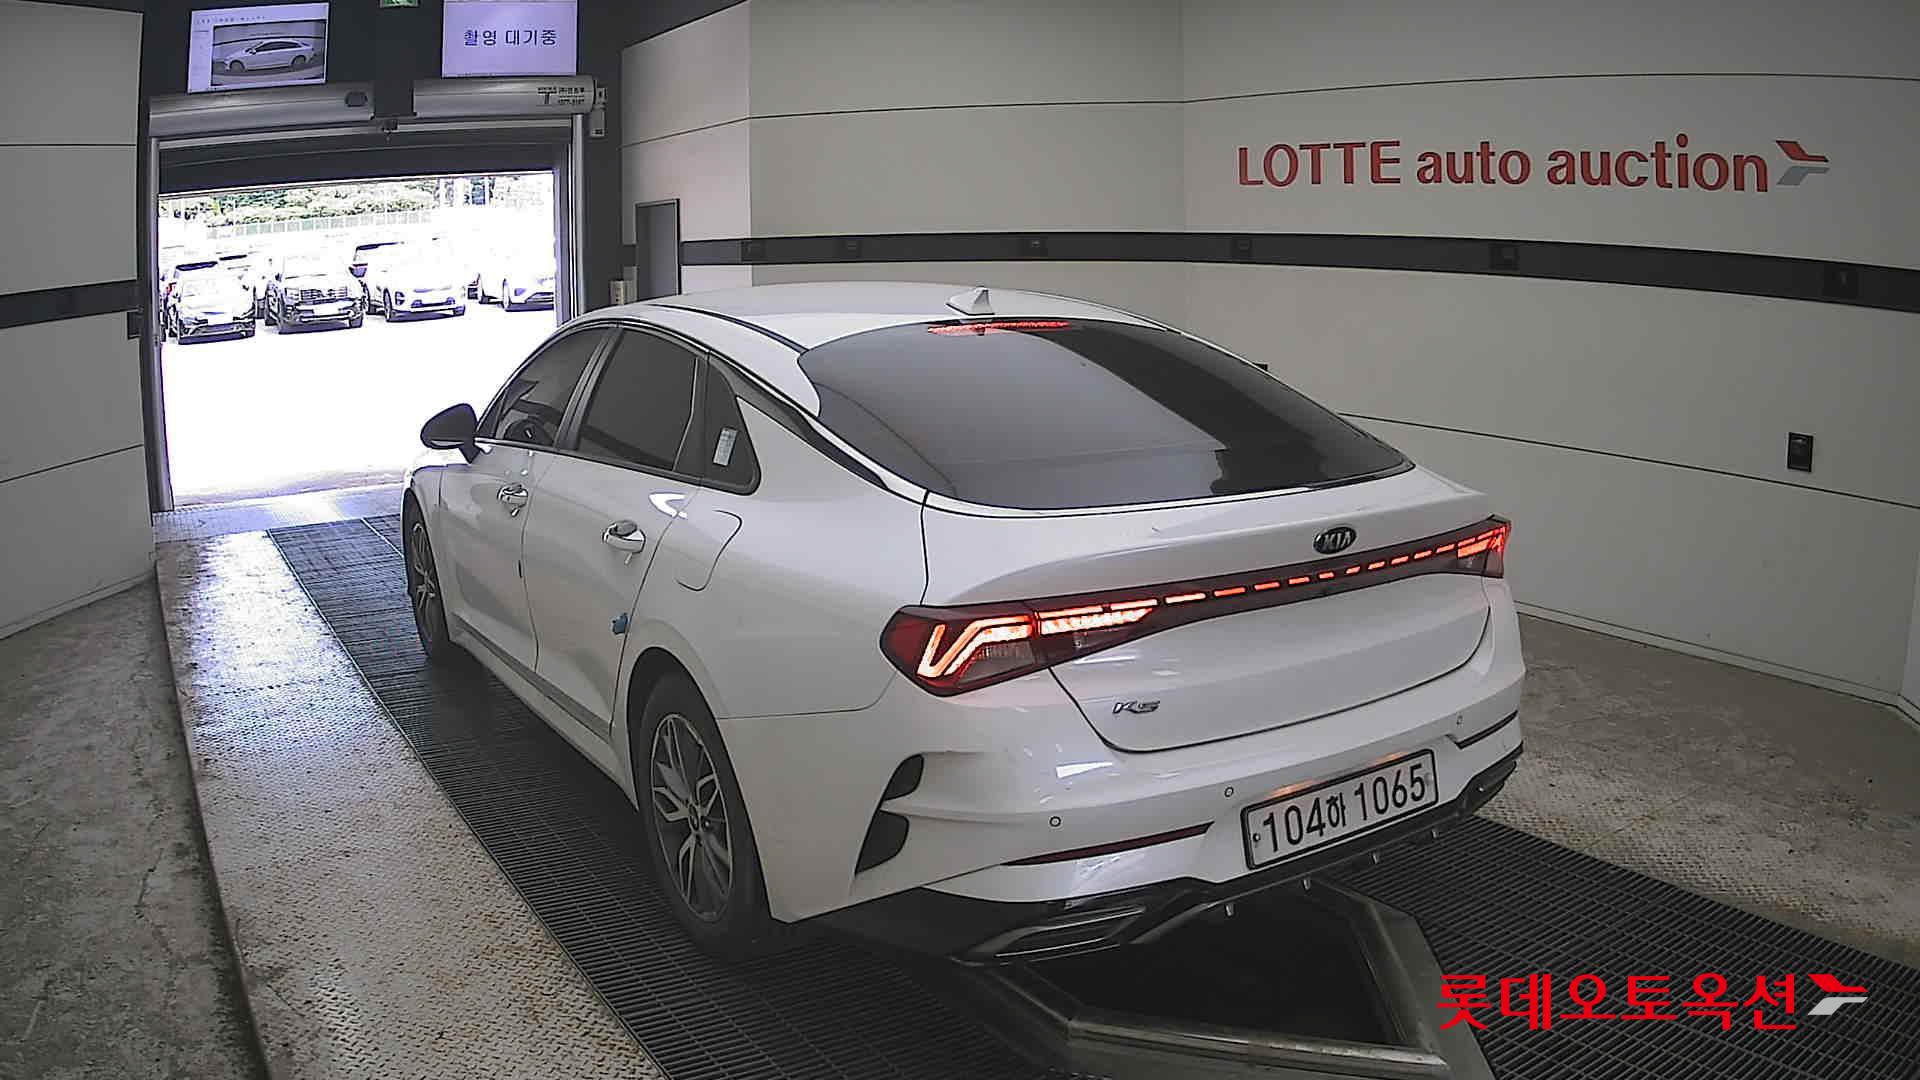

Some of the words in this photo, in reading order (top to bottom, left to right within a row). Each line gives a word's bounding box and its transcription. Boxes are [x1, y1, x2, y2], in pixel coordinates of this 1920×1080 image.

[464, 29, 497, 46] 촬영
[505, 29, 558, 46] 대기중
[1238, 140, 1401, 187] LOTTE
[1416, 141, 1531, 184] auto
[1547, 133, 1768, 192] auction
[1319, 528, 1354, 551] KIA
[1112, 700, 1160, 714] K5
[1263, 792, 1347, 852] 104하
[1354, 763, 1426, 821] 1065
